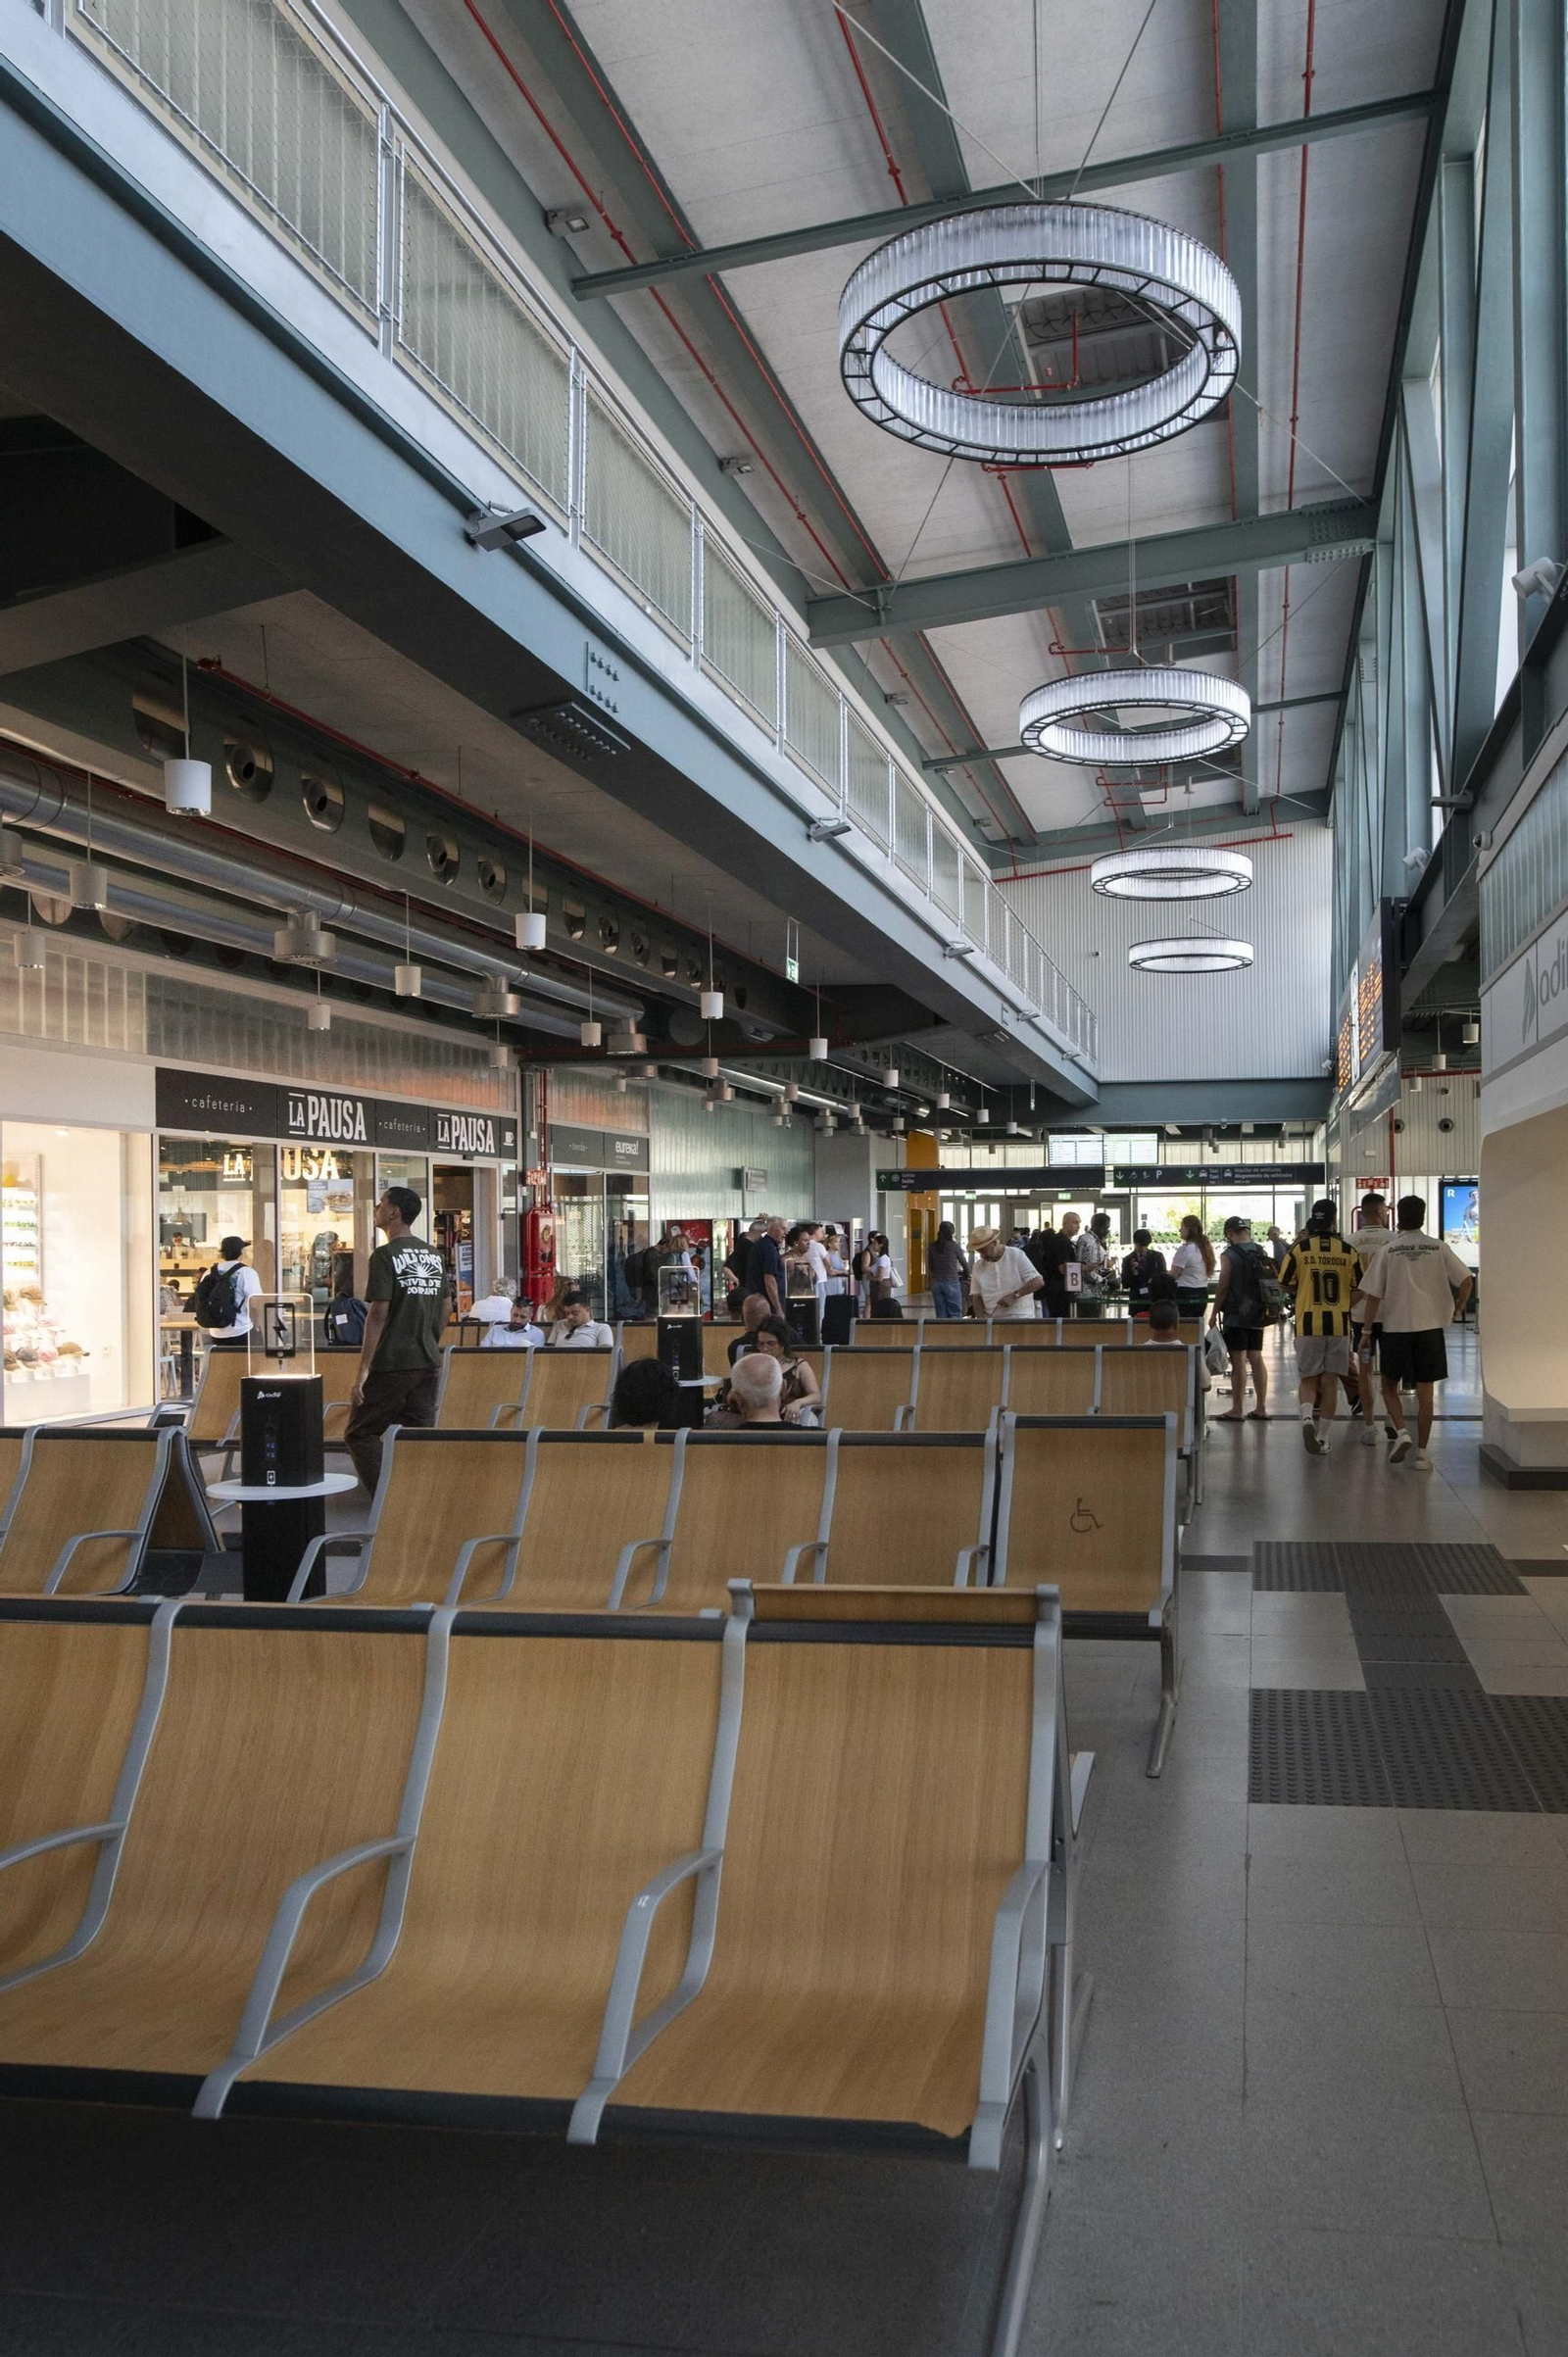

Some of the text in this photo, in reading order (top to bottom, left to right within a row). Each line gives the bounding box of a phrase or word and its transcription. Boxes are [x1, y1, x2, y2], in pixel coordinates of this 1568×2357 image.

[1540, 934, 1568, 1007] adi
[288, 1096, 367, 1141] LA PAUSA
[438, 1115, 495, 1154] LA PAUSA
[223, 1154, 246, 1176] LA
[1070, 1272, 1079, 1287] B
[1310, 1268, 1341, 1305] 10
